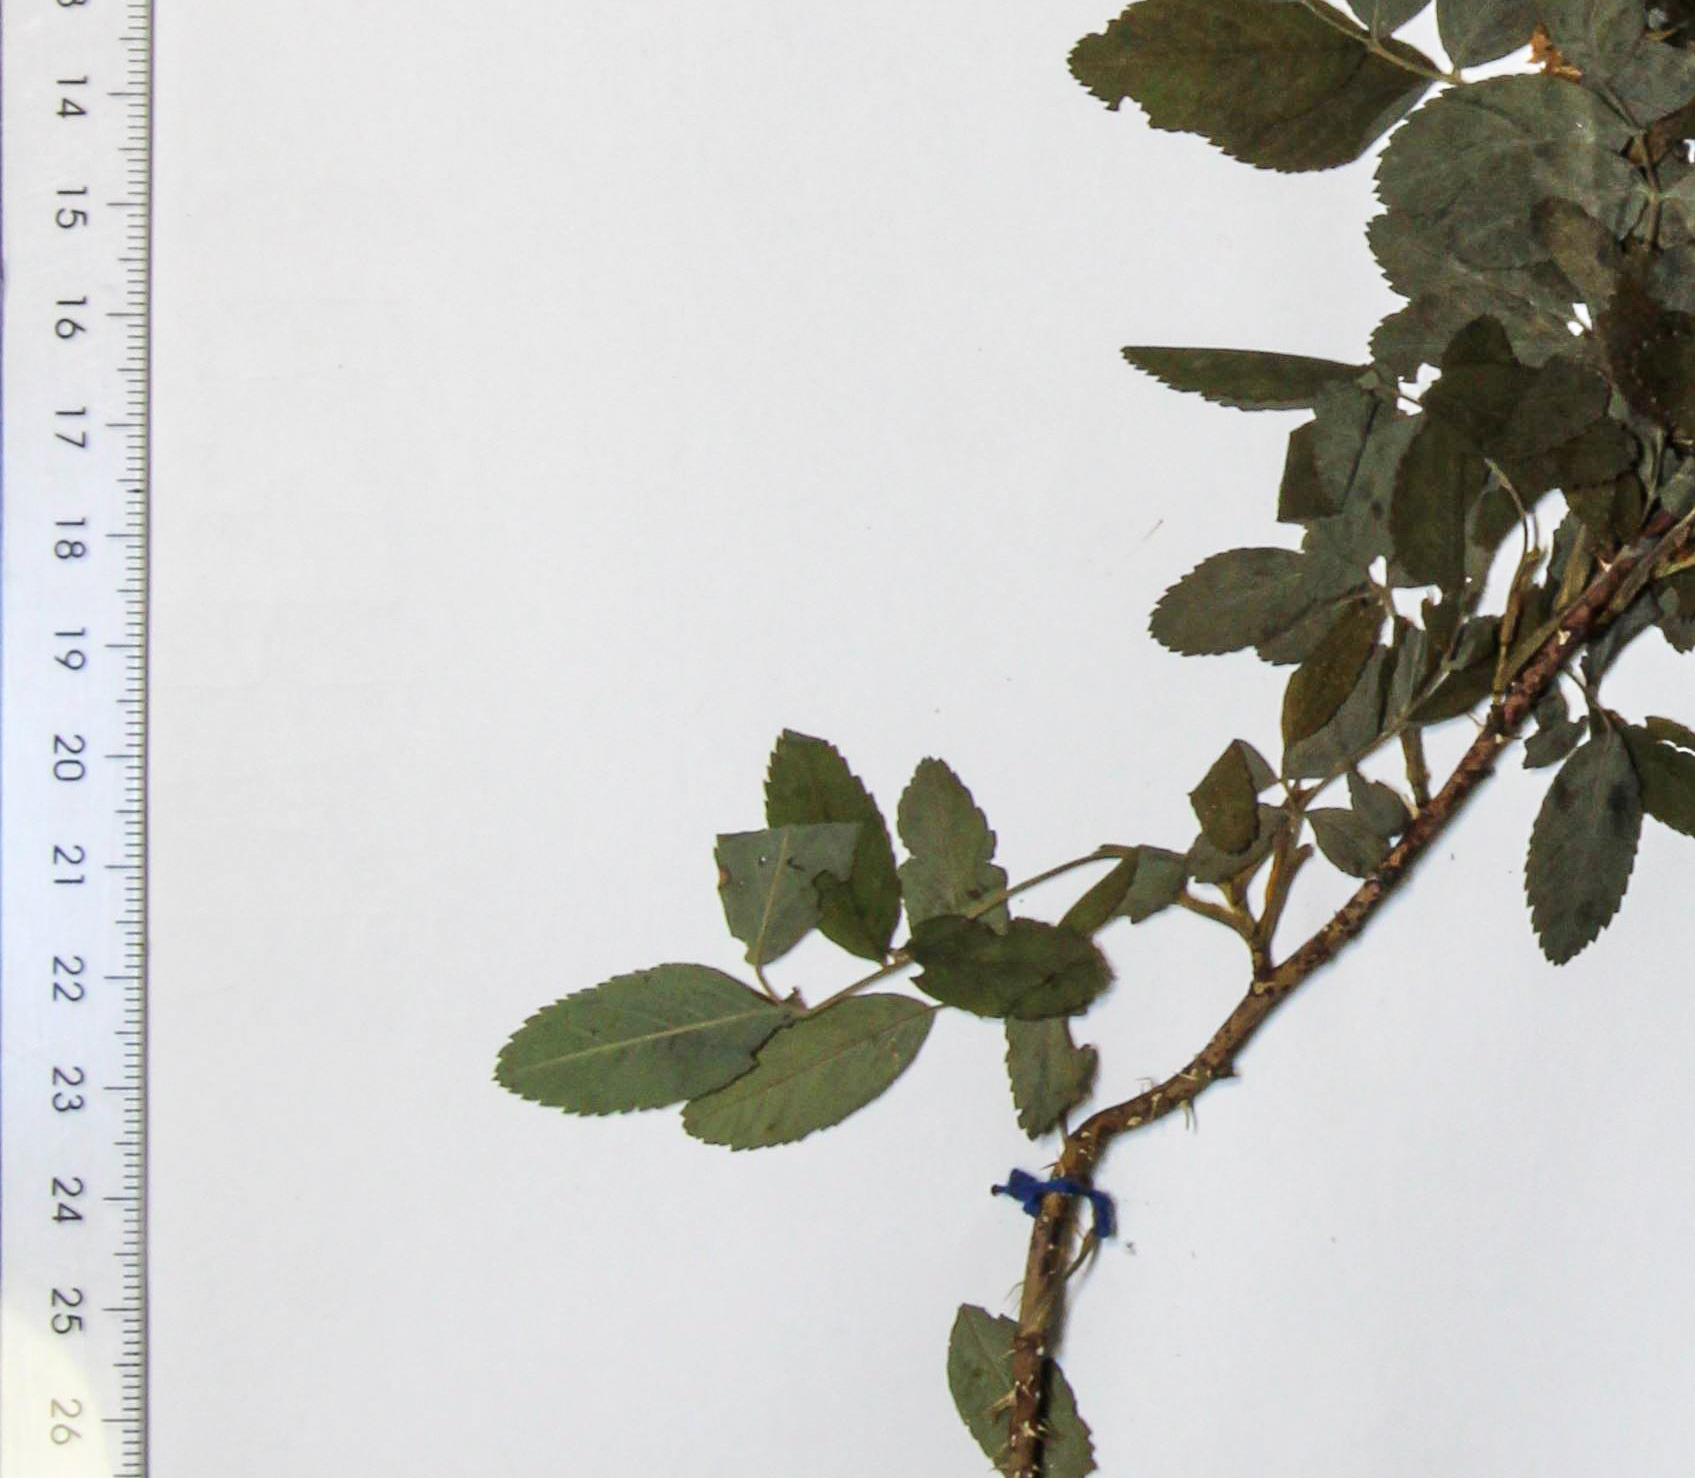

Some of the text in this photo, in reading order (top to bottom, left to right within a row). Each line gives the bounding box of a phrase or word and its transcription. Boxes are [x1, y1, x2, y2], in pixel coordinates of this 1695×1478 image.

[54, 75, 90, 119] 14
[54, 185, 89, 232] 15
[54, 295, 90, 342] 16
[54, 406, 90, 451] 17
[53, 517, 89, 563] 18
[53, 627, 88, 673] 19
[52, 734, 87, 783] 20
[52, 844, 86, 886] 21
[51, 955, 87, 1003] 22
[51, 1066, 87, 1116] 23
[50, 1176, 87, 1225] 24
[48, 1287, 86, 1336] 25
[48, 1398, 83, 1448] 26
